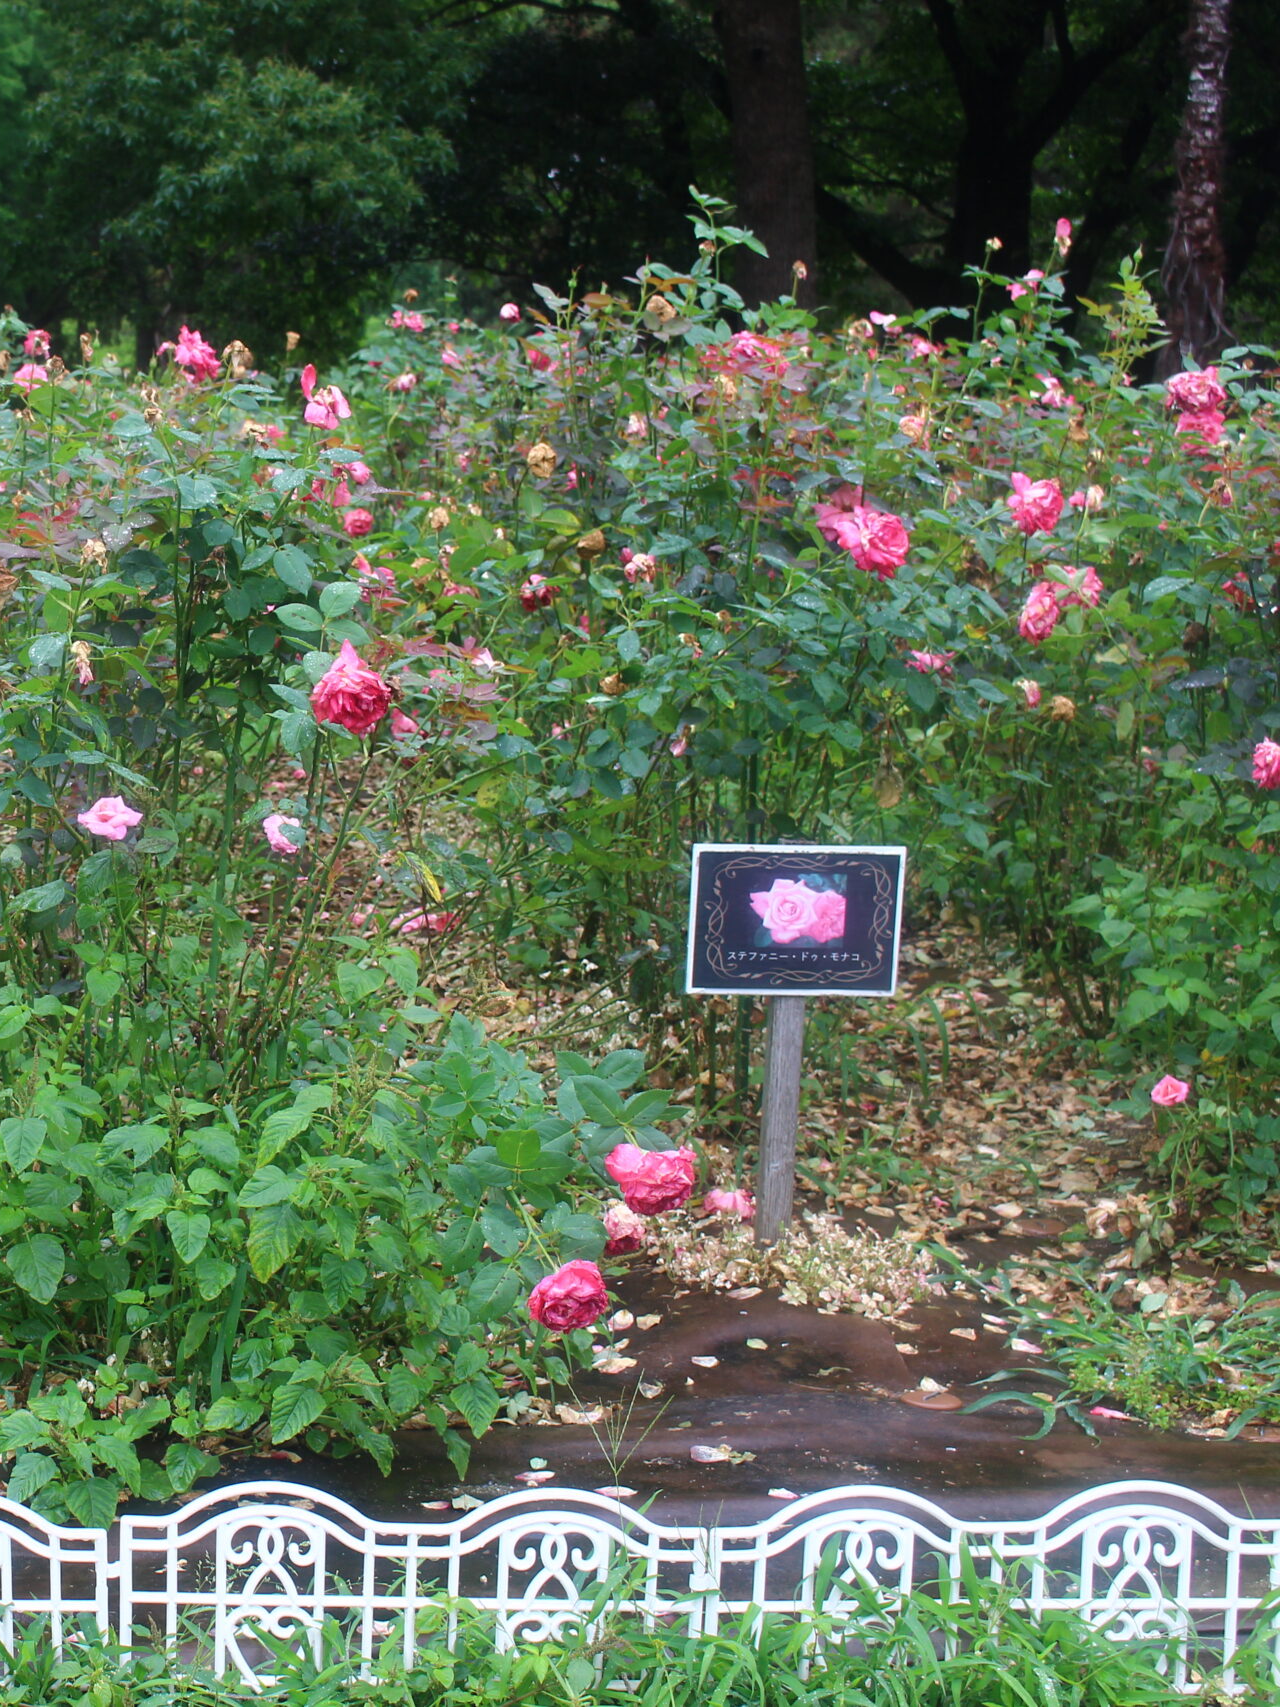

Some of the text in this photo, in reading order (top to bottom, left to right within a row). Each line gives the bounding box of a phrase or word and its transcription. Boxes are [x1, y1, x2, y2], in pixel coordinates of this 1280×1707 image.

[727, 951, 860, 962] ステファニー・ドゥ・モナコ
